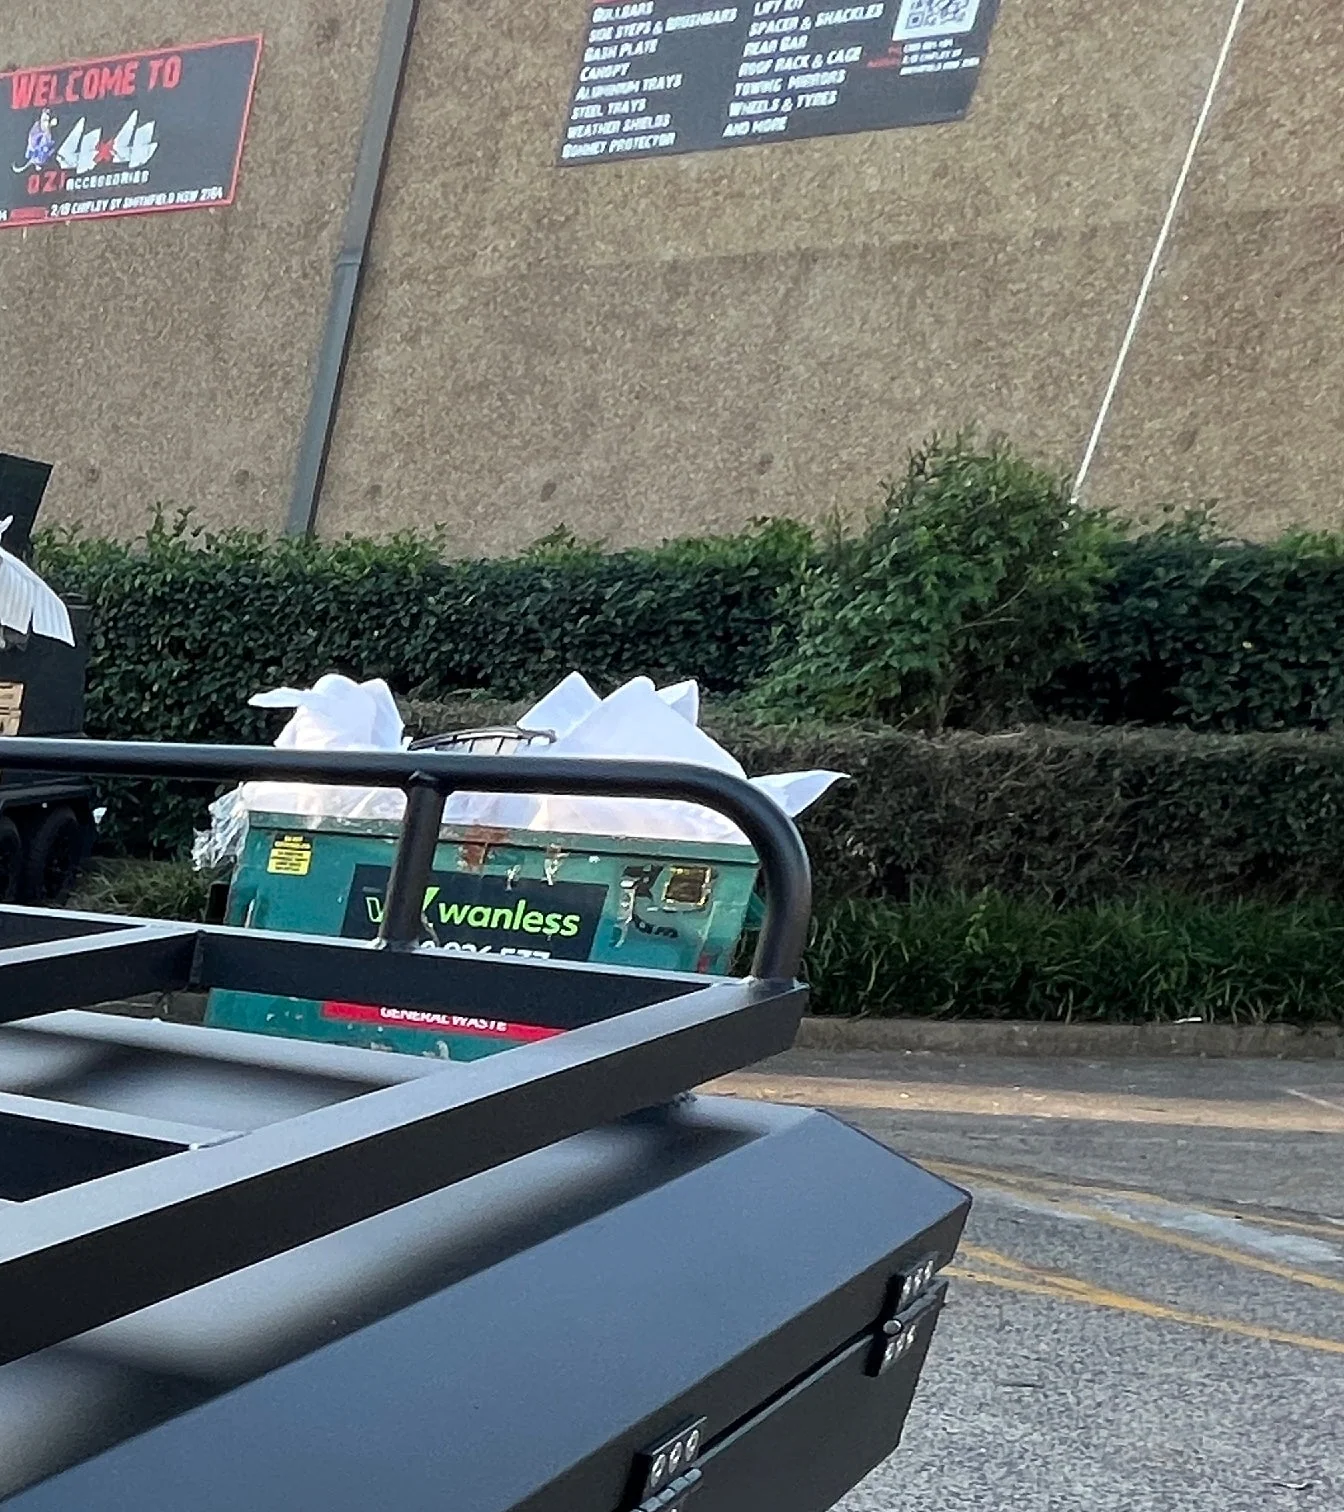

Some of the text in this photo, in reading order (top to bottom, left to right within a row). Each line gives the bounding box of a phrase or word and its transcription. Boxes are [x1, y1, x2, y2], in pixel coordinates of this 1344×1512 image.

[753, 0, 783, 17] LIFT
[614, 21, 652, 40] STEPS
[652, 20, 663, 36] &
[748, 3, 885, 38] SPACER & SHACKLES
[743, 34, 809, 58] REAR BAR
[580, 62, 631, 82] CANOPY
[738, 59, 774, 78] ROOF
[774, 54, 811, 73] RACK
[811, 53, 824, 70] &
[826, 46, 863, 65] CAGE
[11, 55, 182, 109] WELCOME TO
[642, 73, 683, 92] TRAYS
[734, 78, 784, 97] TOWING
[607, 98, 647, 115] TRAYS
[728, 98, 781, 118] WHEELS
[781, 97, 794, 112] &
[566, 120, 621, 140] WEATHER
[722, 116, 788, 138] AND MORE
[109, 198, 123, 211] ST
[438, 899, 581, 937] wanless
[380, 1007, 508, 1032] GENERAL WASTE
